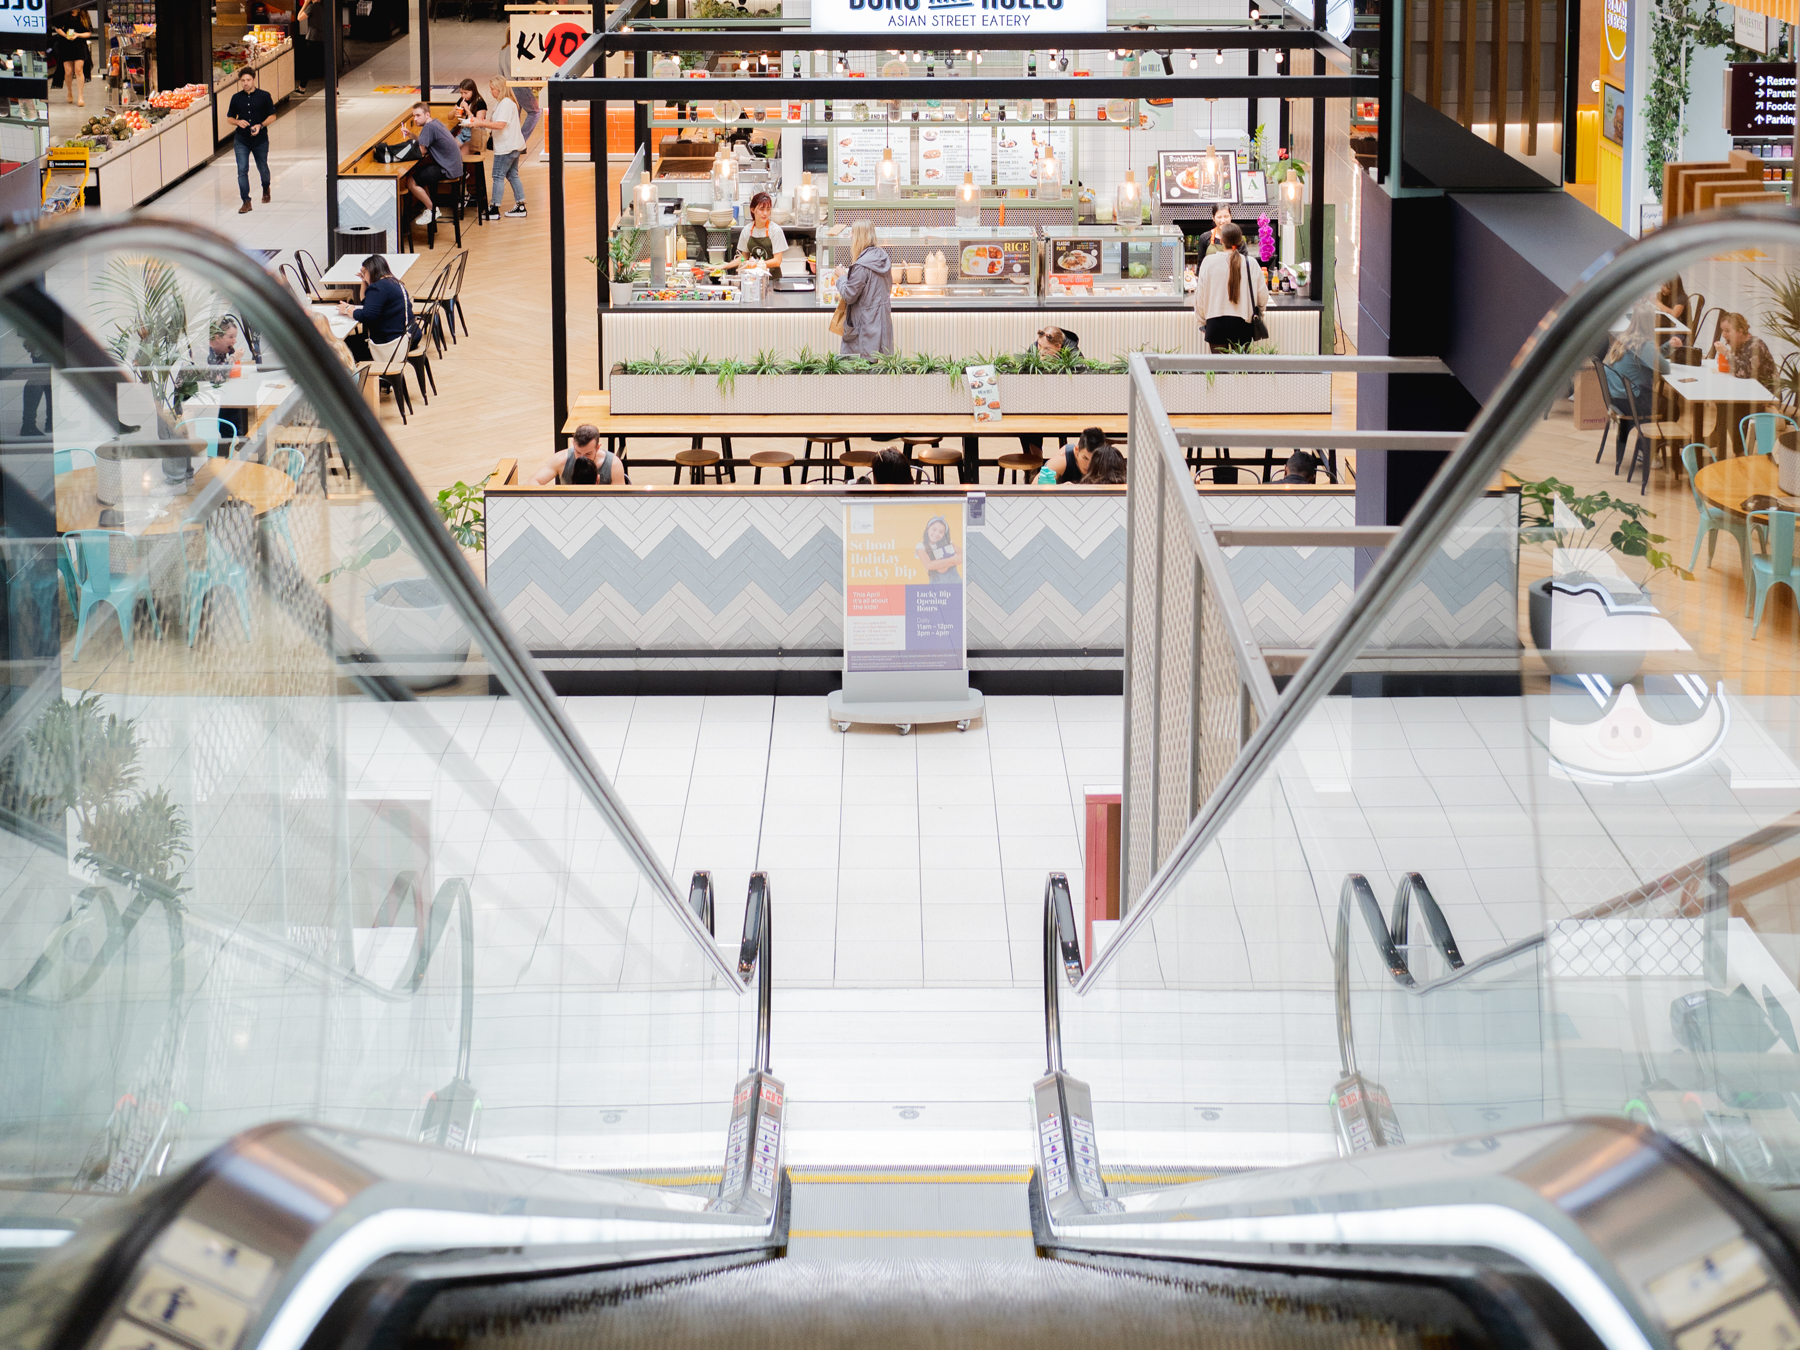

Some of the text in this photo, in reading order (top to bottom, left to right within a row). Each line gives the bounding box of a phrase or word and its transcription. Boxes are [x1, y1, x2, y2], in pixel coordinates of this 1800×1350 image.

[888, 15, 1030, 26] ASIAN STREET EATERY
[516, 31, 592, 63] KYO
[1248, 178, 1258, 189] A
[1004, 242, 1029, 252] RICE
[850, 539, 895, 550] School
[850, 553, 901, 565] Holiday
[850, 565, 916, 579] Lucky Dip
[940, 590, 951, 599] Dip
